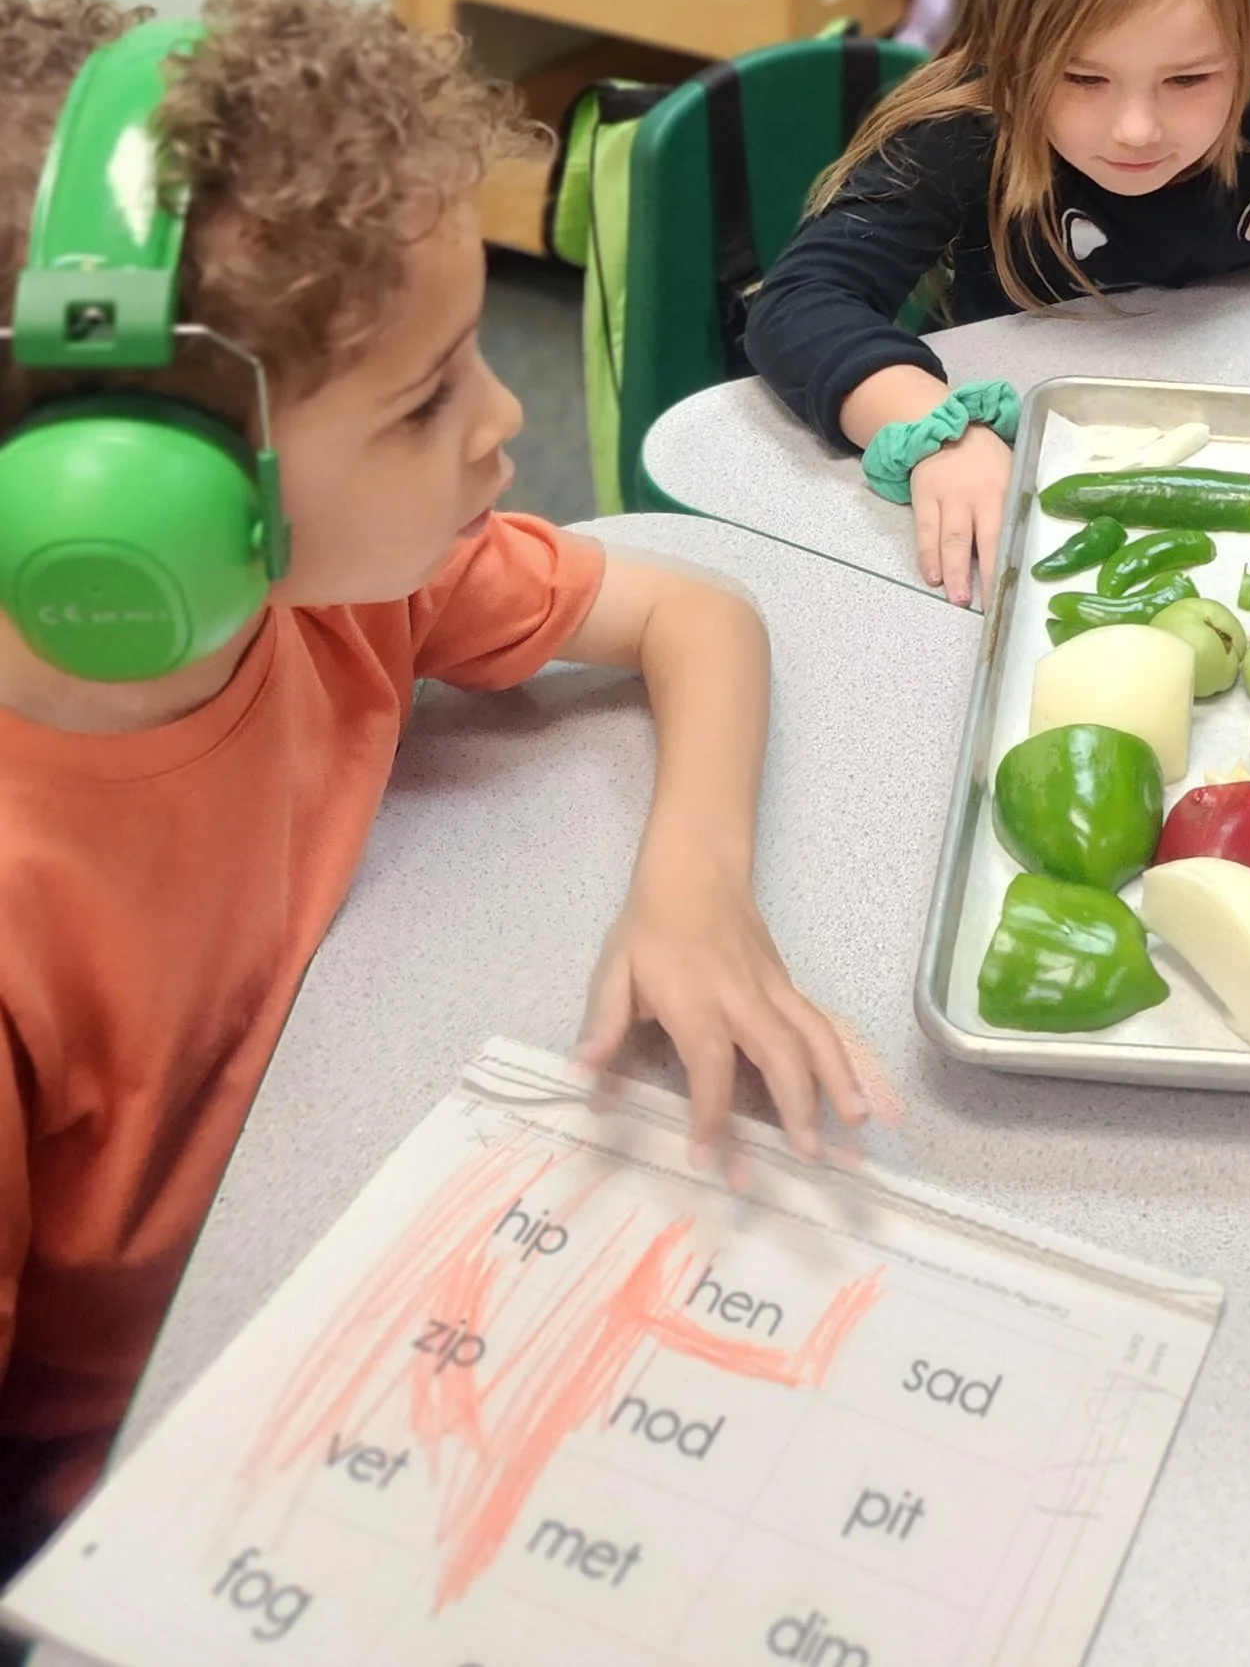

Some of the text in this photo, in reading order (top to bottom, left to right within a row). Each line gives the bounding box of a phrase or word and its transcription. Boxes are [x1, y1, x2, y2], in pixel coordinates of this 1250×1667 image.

[493, 1197, 568, 1262] hip
[686, 1266, 784, 1336] hen
[412, 1319, 486, 1374] zip
[902, 1358, 1003, 1417] sad
[608, 1393, 725, 1460] nod
[325, 1433, 409, 1490] vet
[842, 1487, 926, 1541] pit
[526, 1519, 641, 1587] met
[212, 1547, 313, 1642] fog
[765, 1609, 869, 1667] dim
